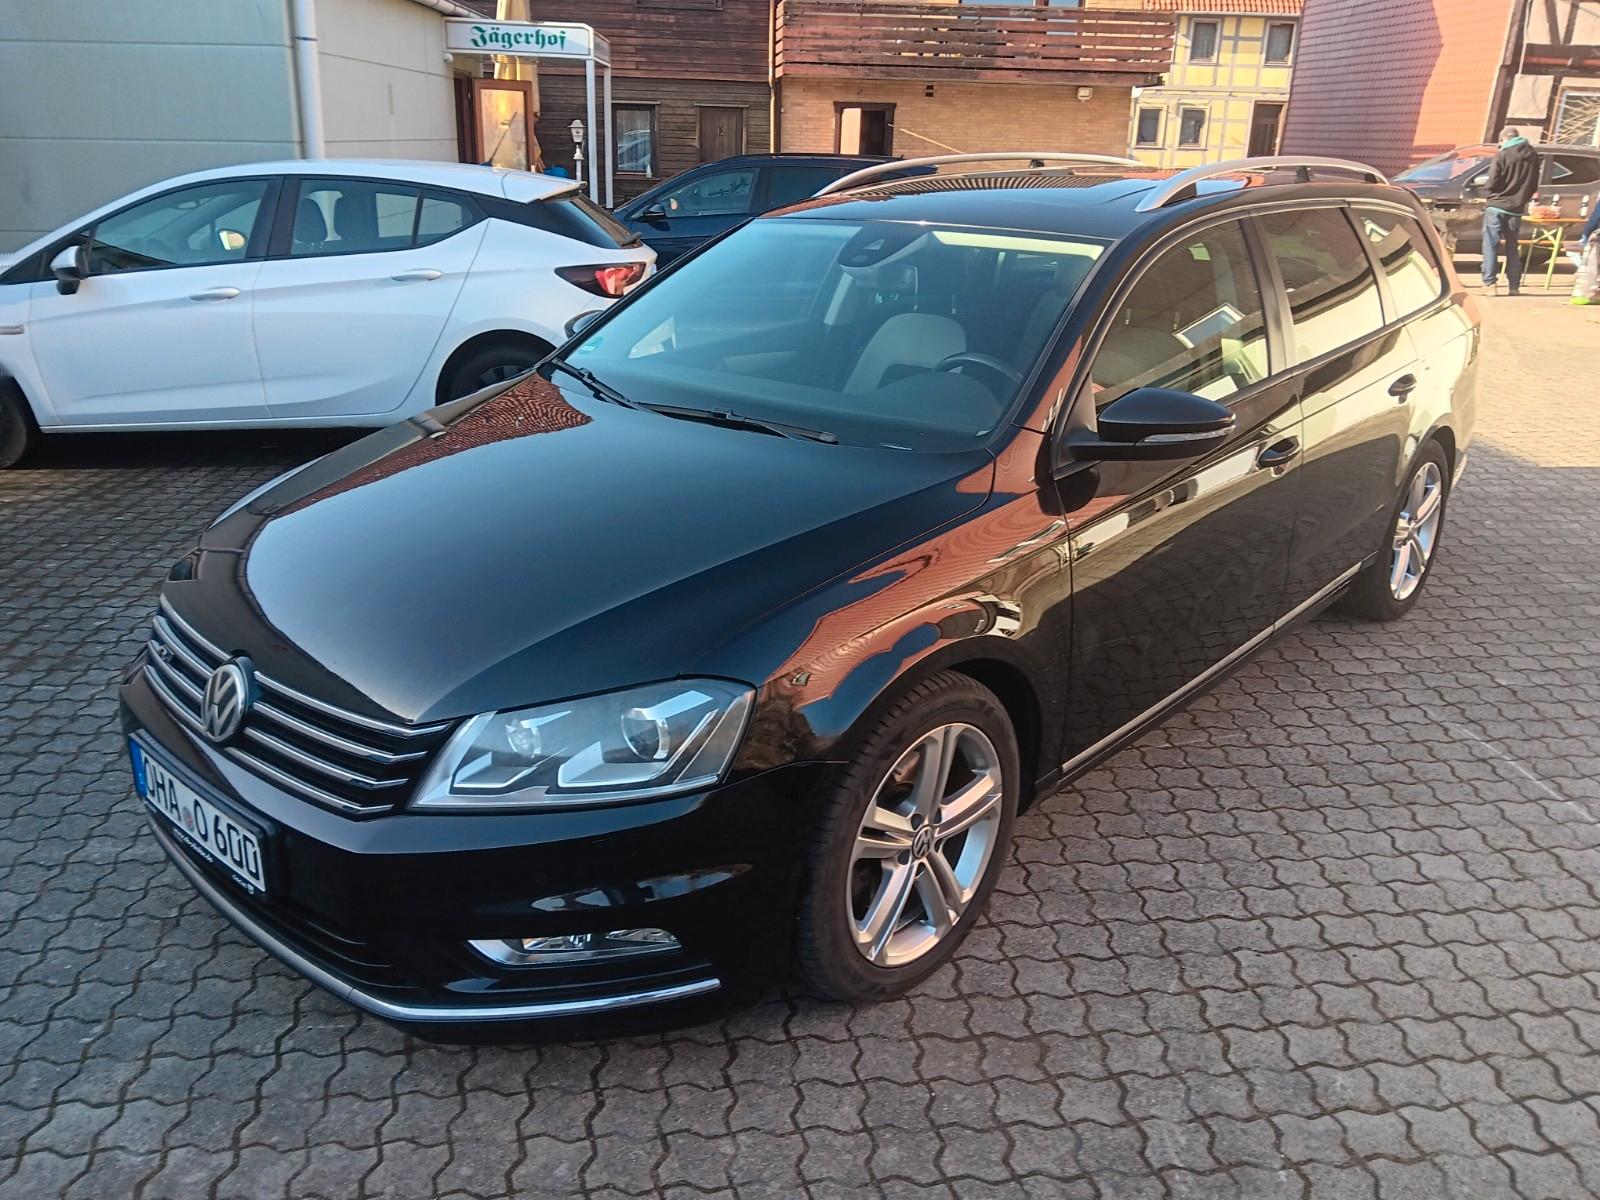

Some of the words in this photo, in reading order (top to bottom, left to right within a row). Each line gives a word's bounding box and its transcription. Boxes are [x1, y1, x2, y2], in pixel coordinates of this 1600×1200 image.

[471, 25, 567, 50] Jägerhof
[144, 756, 182, 822] OHA
[193, 798, 208, 842] O
[214, 814, 260, 881] 600
